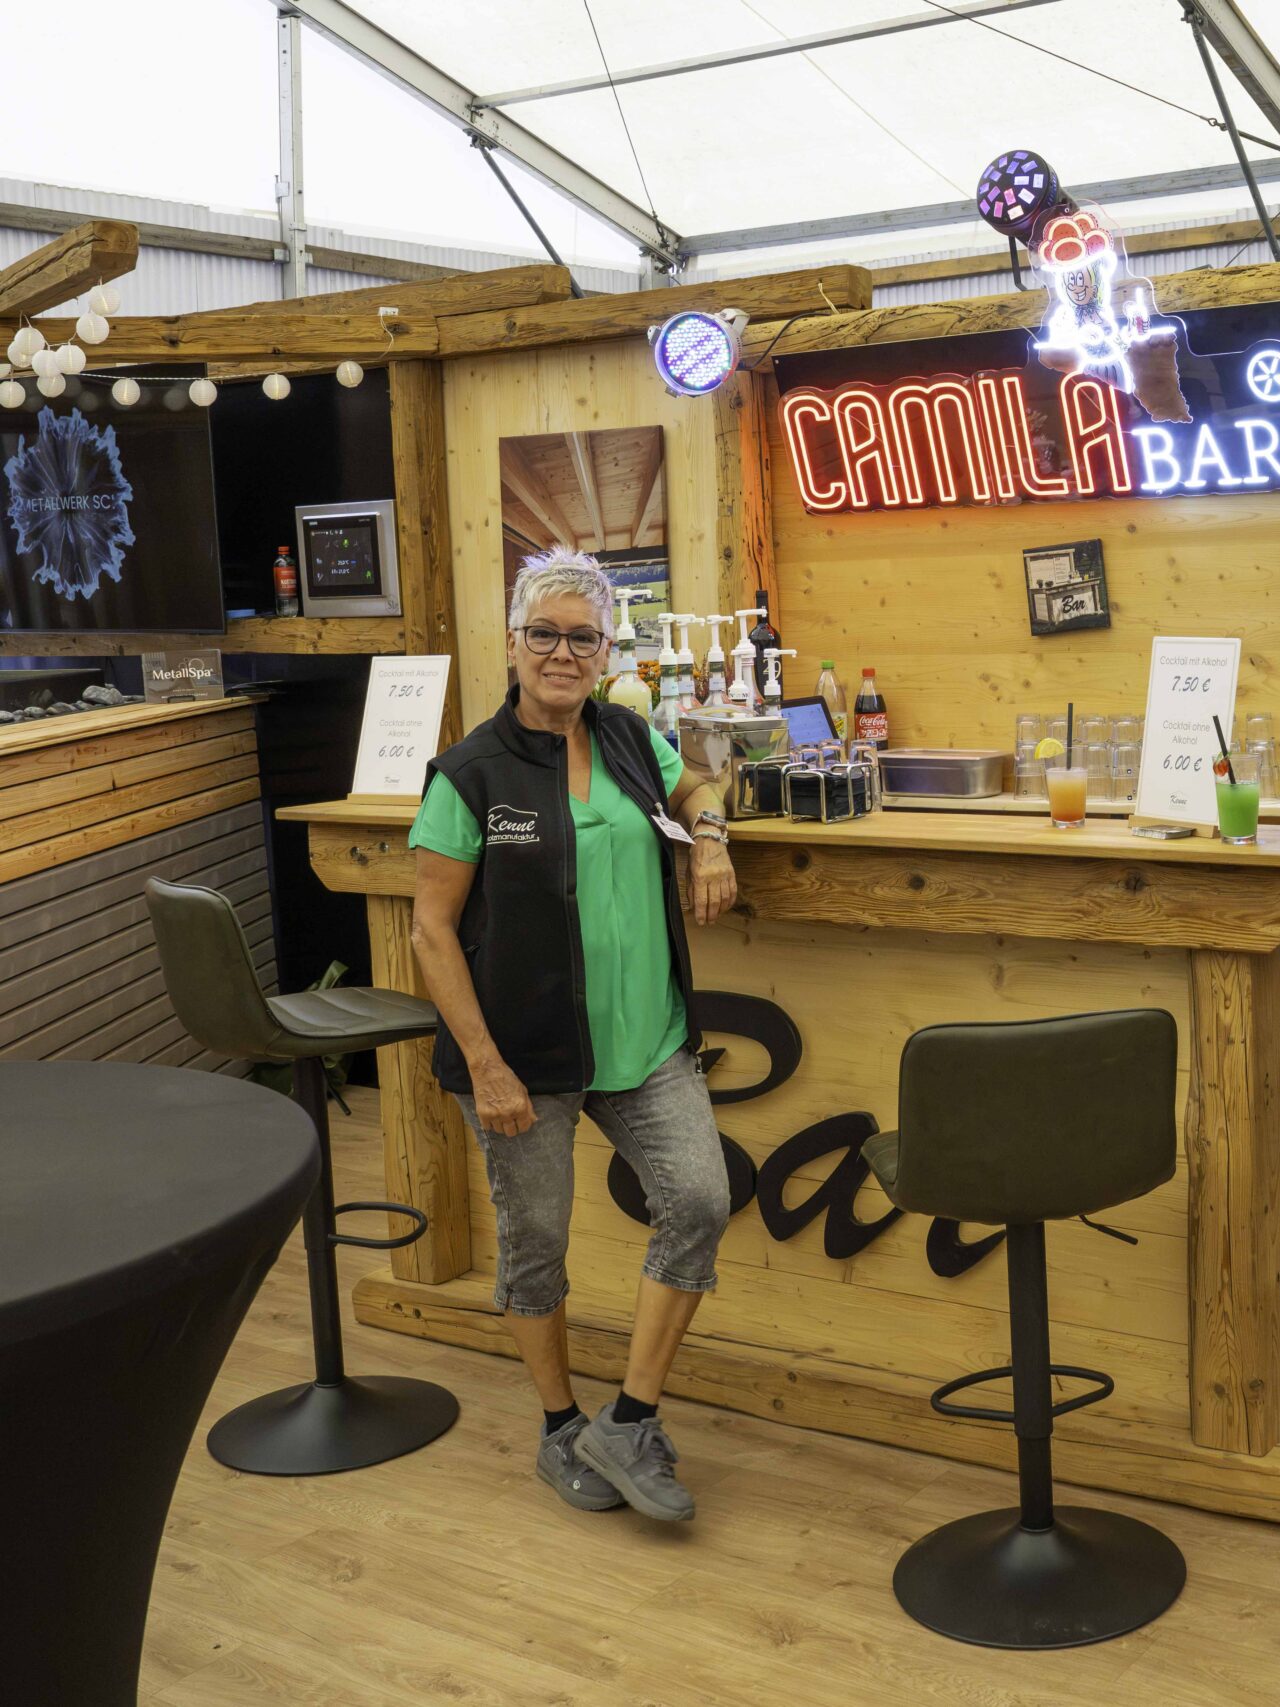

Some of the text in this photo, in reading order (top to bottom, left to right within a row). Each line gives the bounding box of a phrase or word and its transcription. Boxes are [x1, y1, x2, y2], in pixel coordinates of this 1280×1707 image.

[782, 370, 1134, 509] CAMILA
[93, 494, 116, 509] SC
[1061, 594, 1085, 613] Bar
[1160, 656, 1227, 666] Cocktail mit Alkohol
[388, 685, 424, 698] 7.50 €
[1172, 676, 1211, 692] 7.50 €
[1163, 720, 1210, 732] Cocktail ohne
[1172, 735, 1198, 745] Alkohol
[379, 745, 415, 758] 6.00 €
[1163, 754, 1202, 772] 6.00 €
[488, 814, 535, 832] Kenne
